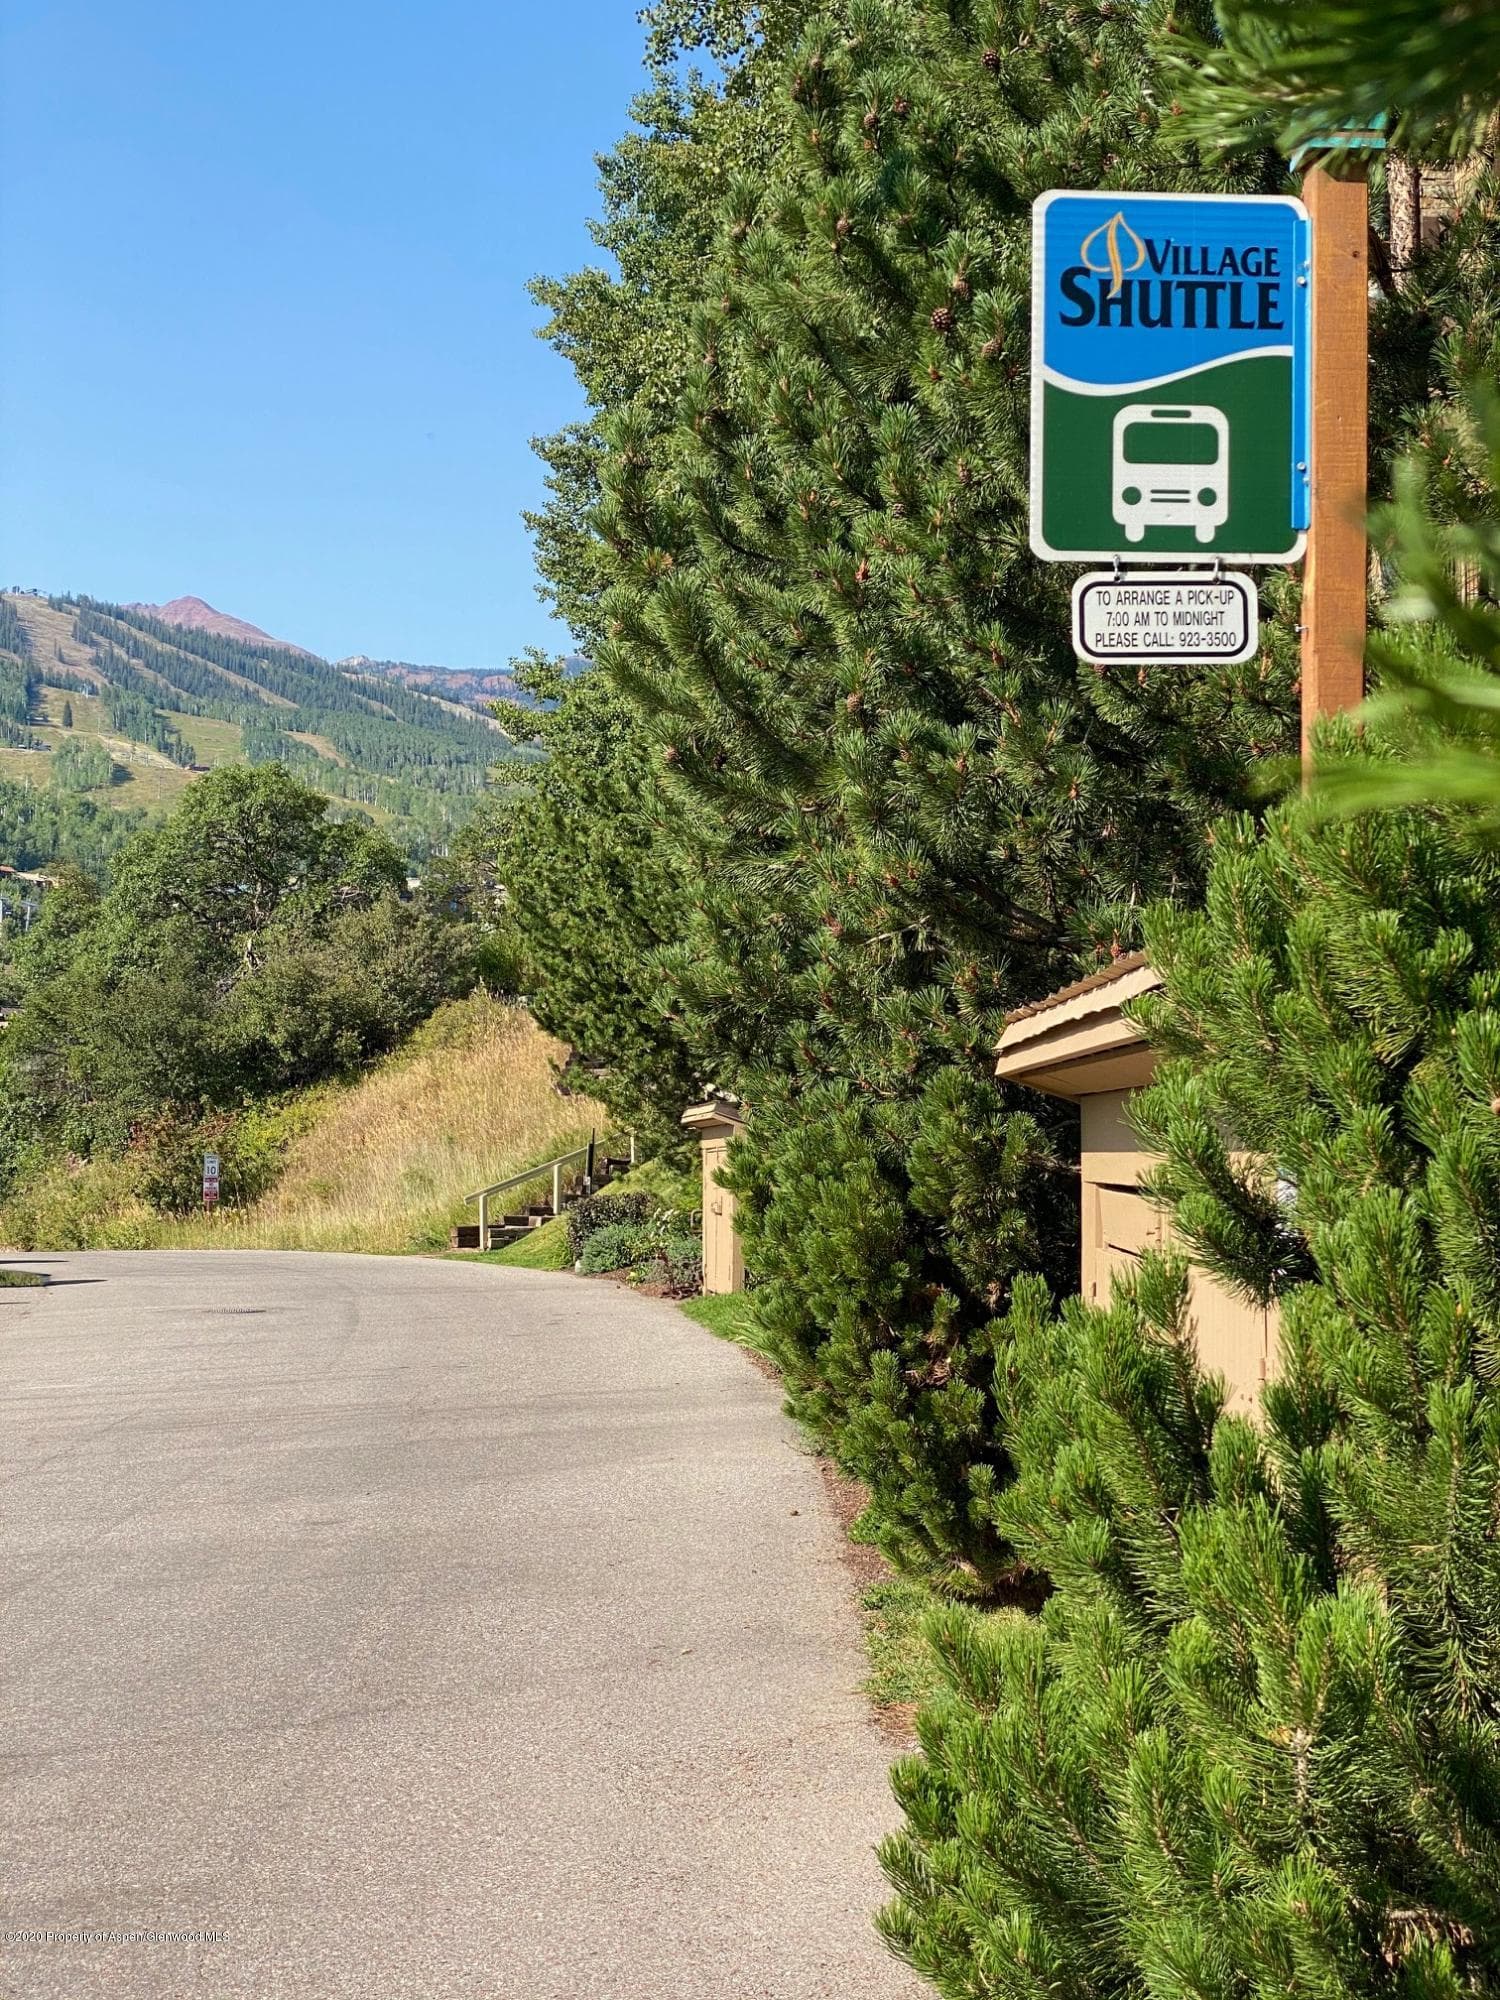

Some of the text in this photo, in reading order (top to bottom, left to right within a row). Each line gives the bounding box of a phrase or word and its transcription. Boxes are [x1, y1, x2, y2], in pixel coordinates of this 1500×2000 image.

[1143, 238, 1281, 277] VILLAGE
[1059, 266, 1284, 330] SHUTTLE
[1096, 590, 1234, 606] TO ARRANGE A PICK-UP
[1106, 611, 1225, 627] 7:00 AM TO MIDNIGHT
[1095, 632, 1236, 647] PLEASE CALL: 923-3500
[207, 1166, 217, 1175] 10
